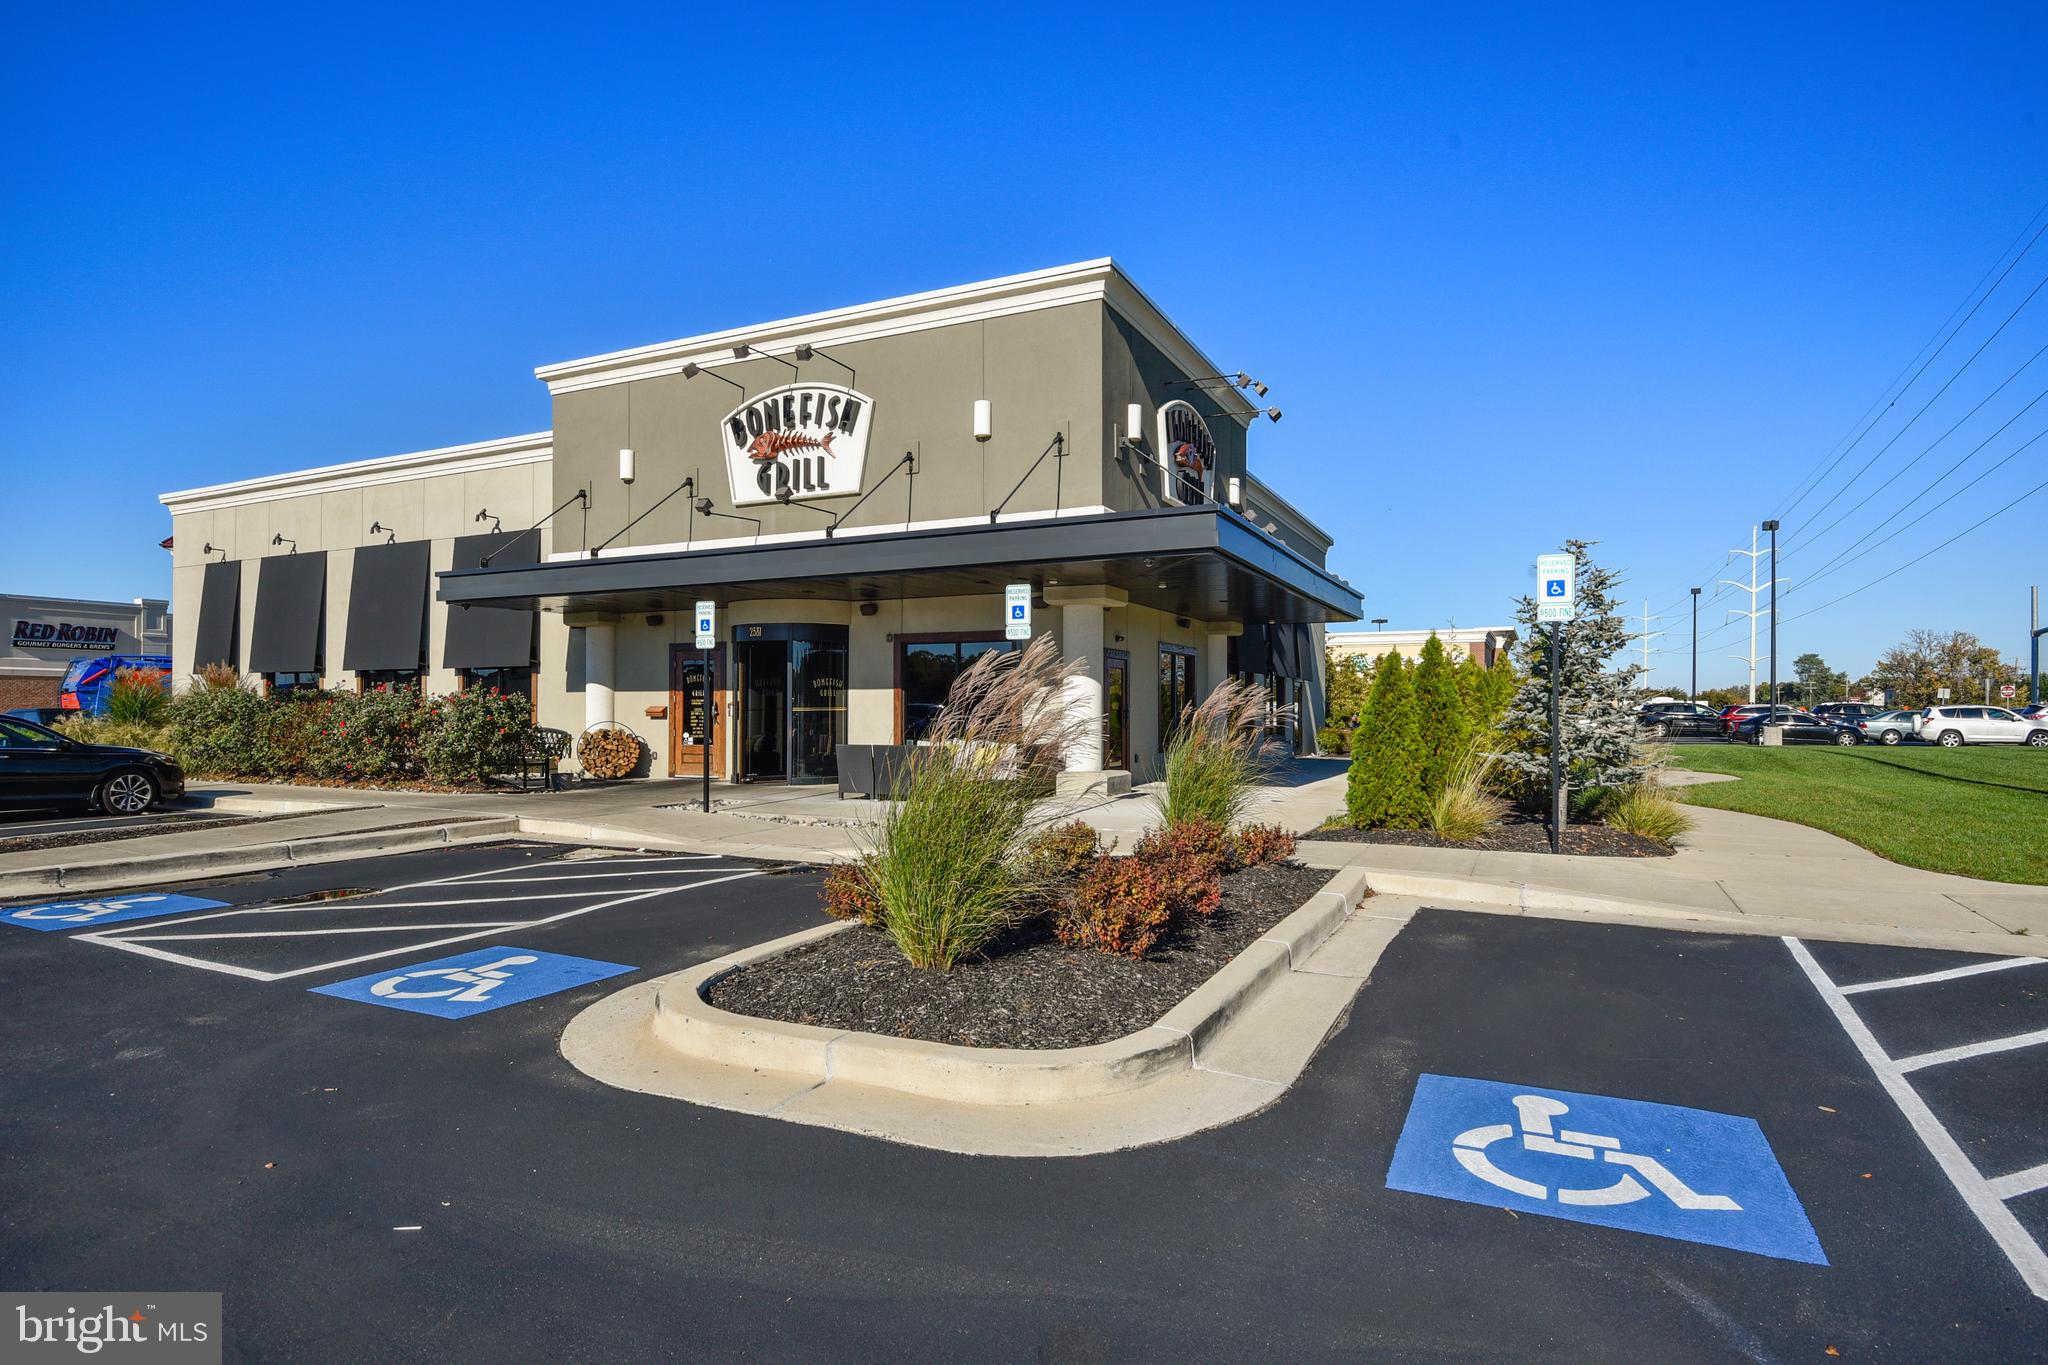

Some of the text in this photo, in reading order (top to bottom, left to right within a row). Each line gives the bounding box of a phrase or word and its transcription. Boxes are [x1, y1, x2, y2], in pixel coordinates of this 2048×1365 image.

[730, 393, 861, 450] BONEFISH
[756, 457, 830, 498] GRILL
[1540, 608, 1572, 617] $500 FINE
[14, 620, 118, 643] RED ROBIN
[17, 640, 50, 648] GOURMET
[686, 674, 712, 684] BONEF
